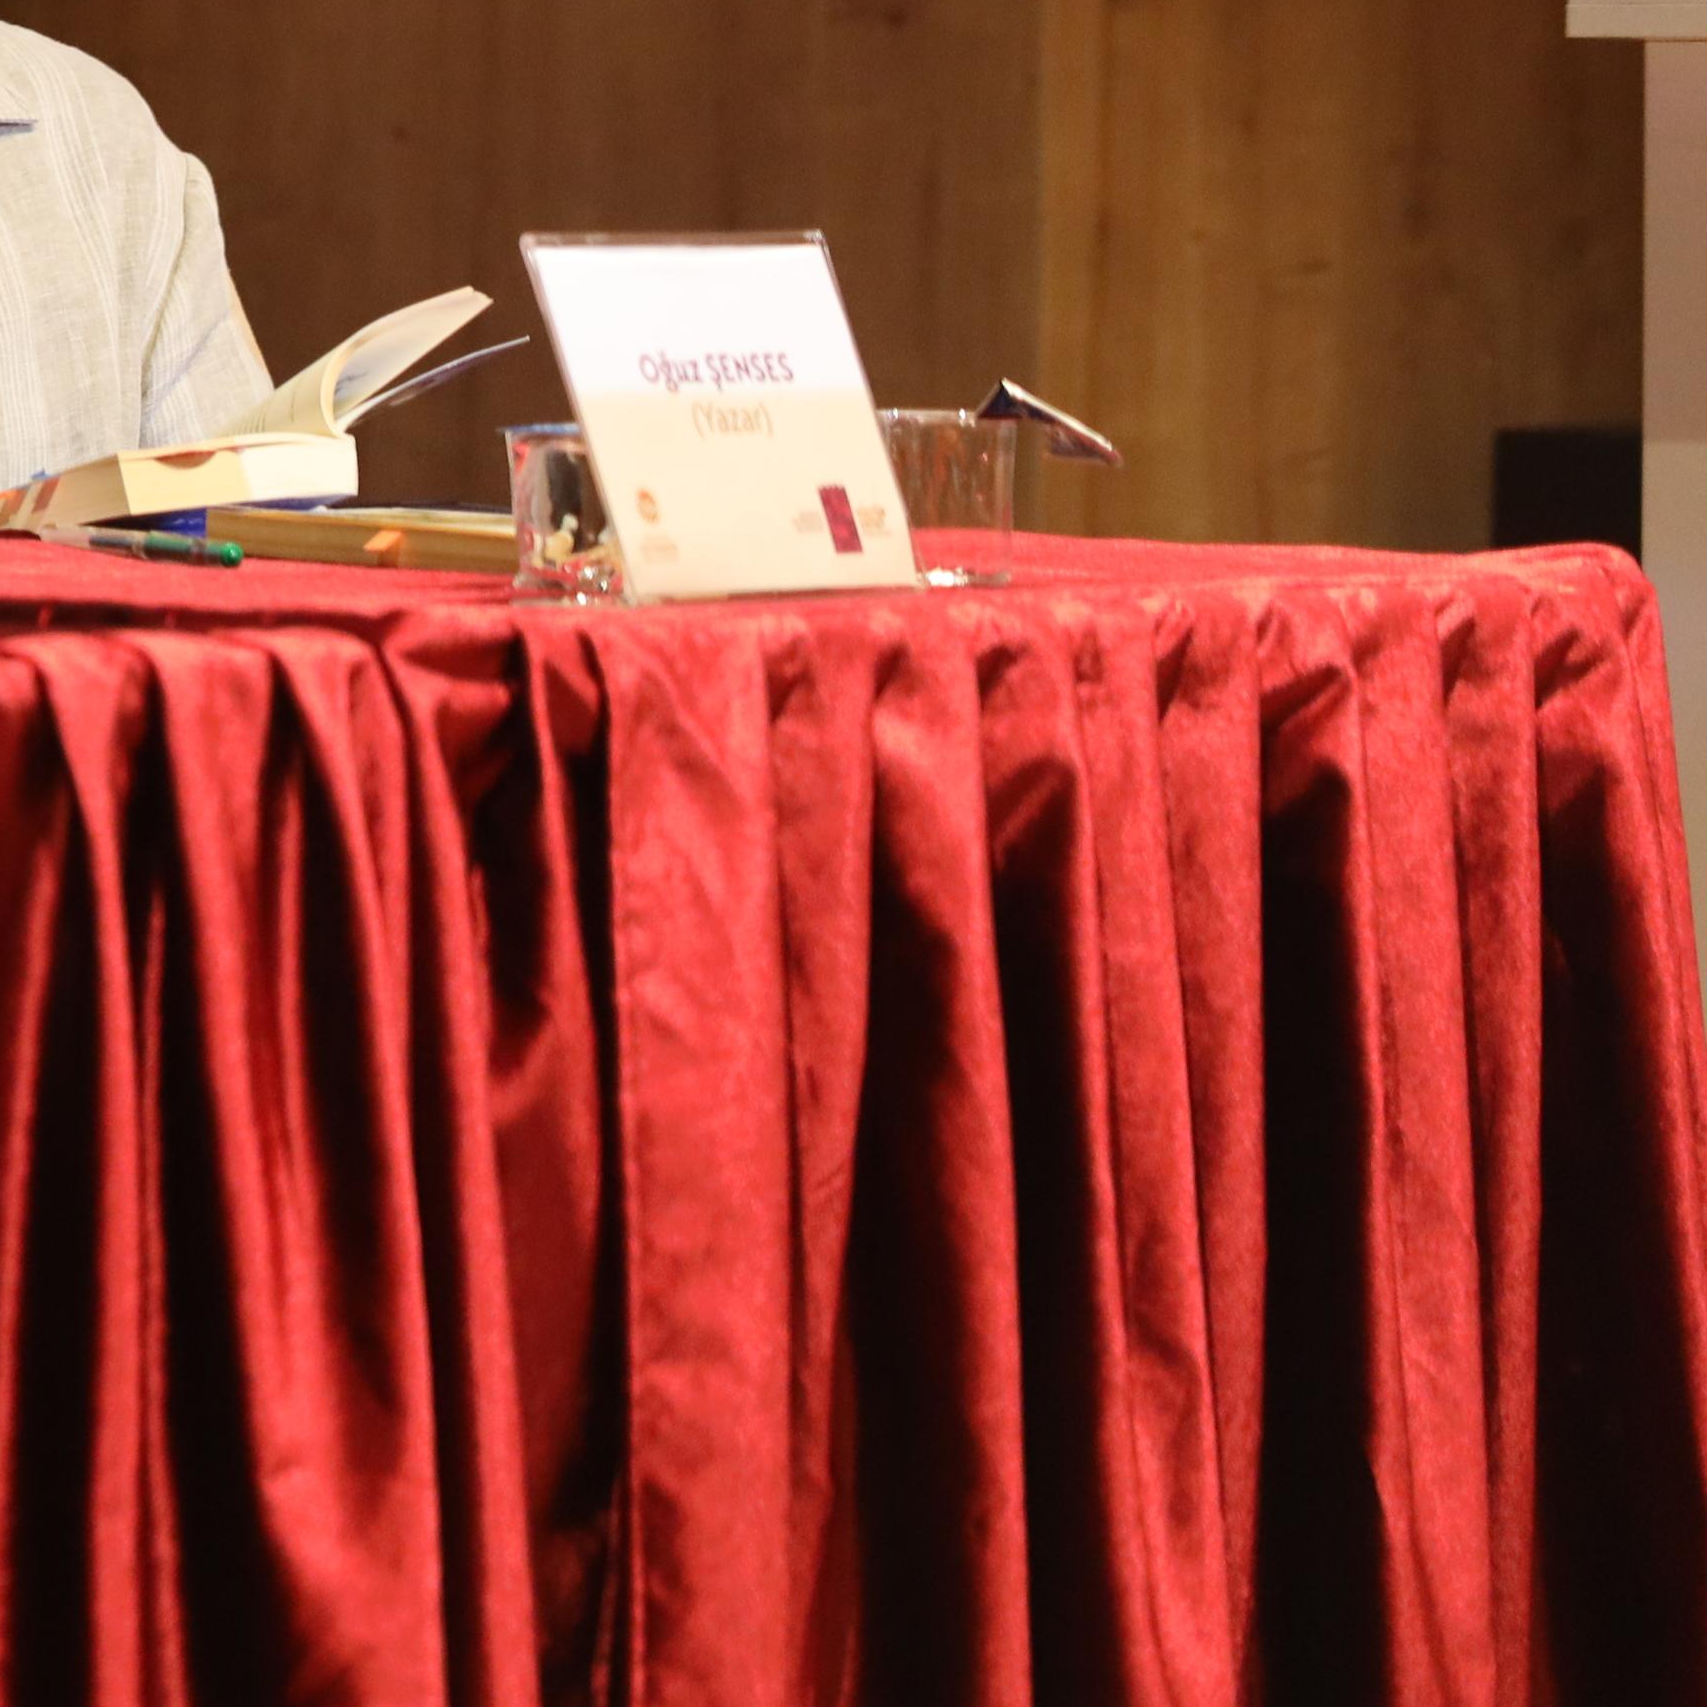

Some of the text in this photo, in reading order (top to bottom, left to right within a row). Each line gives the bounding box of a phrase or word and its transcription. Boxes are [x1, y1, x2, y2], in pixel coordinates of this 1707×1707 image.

[637, 349, 795, 395] Oğuz ŞENSES
[691, 399, 775, 443] (Yazar)
